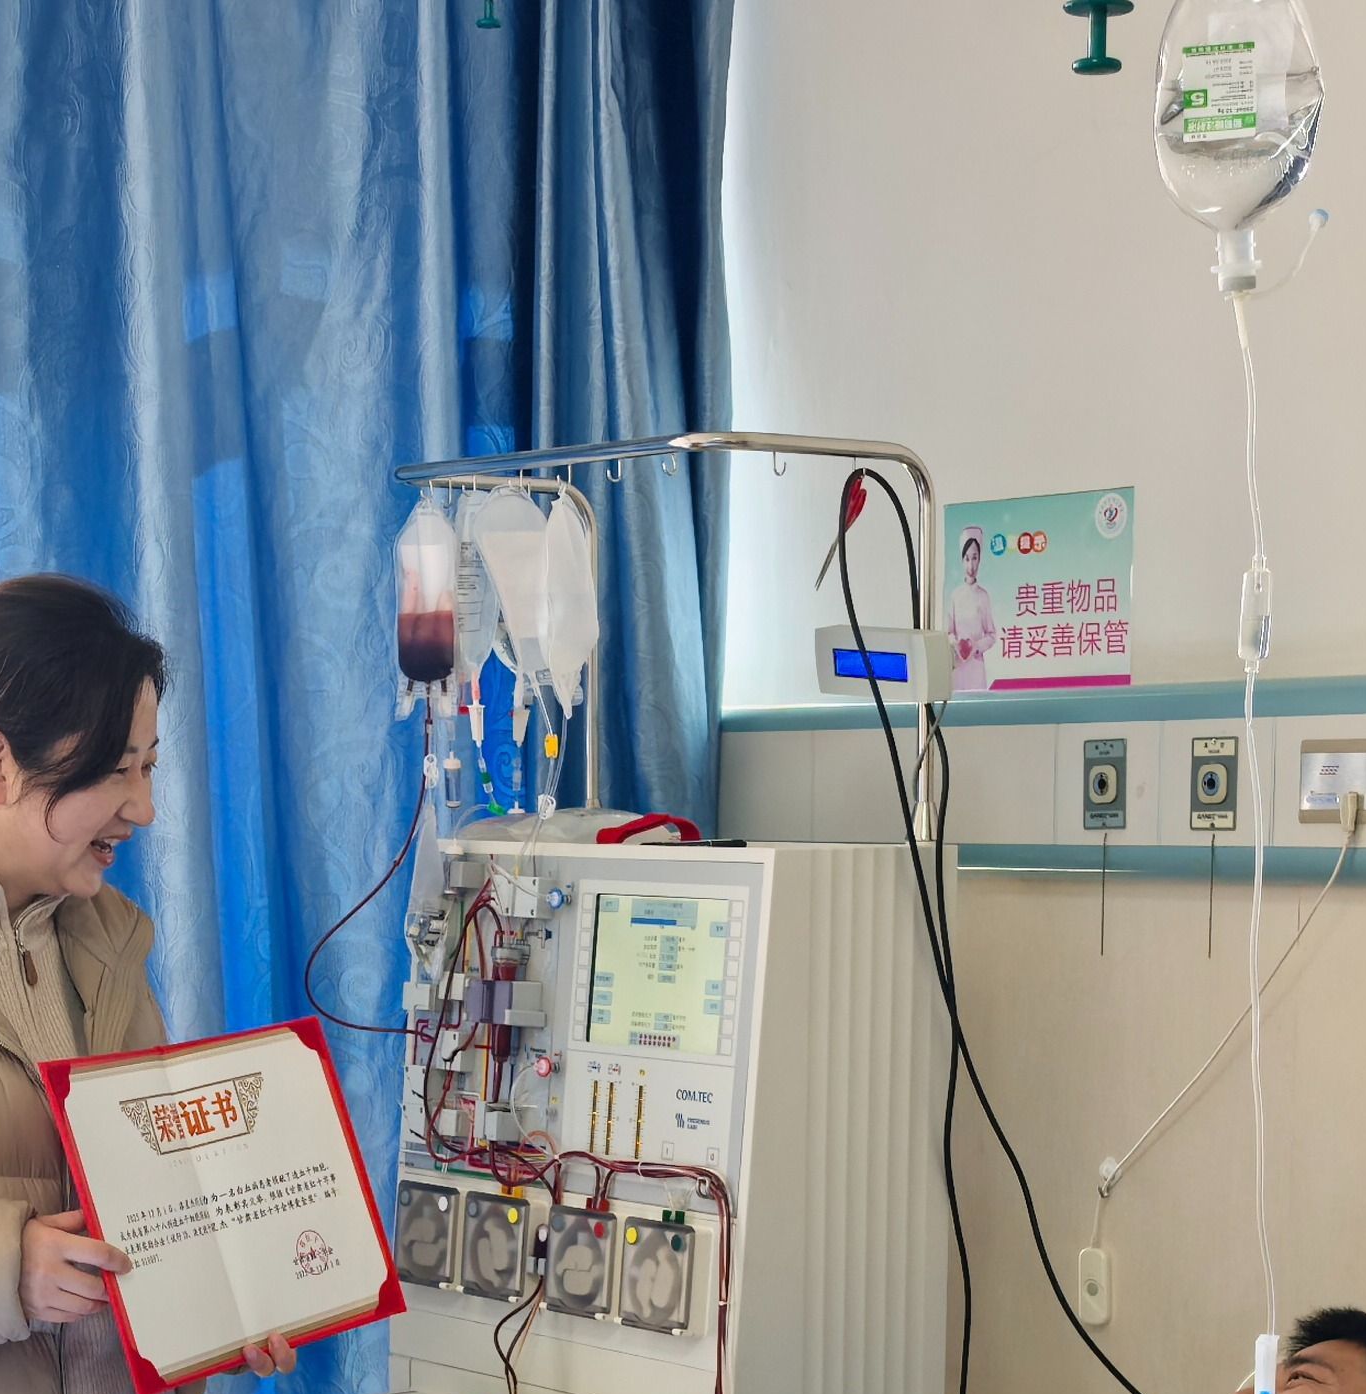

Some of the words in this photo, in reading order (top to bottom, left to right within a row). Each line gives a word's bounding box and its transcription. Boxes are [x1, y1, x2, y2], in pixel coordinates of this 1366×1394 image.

[1015, 578, 1119, 617] 贵重物品
[1000, 619, 1129, 660] 请妥善保管
[676, 1088, 714, 1104] COM.TEC
